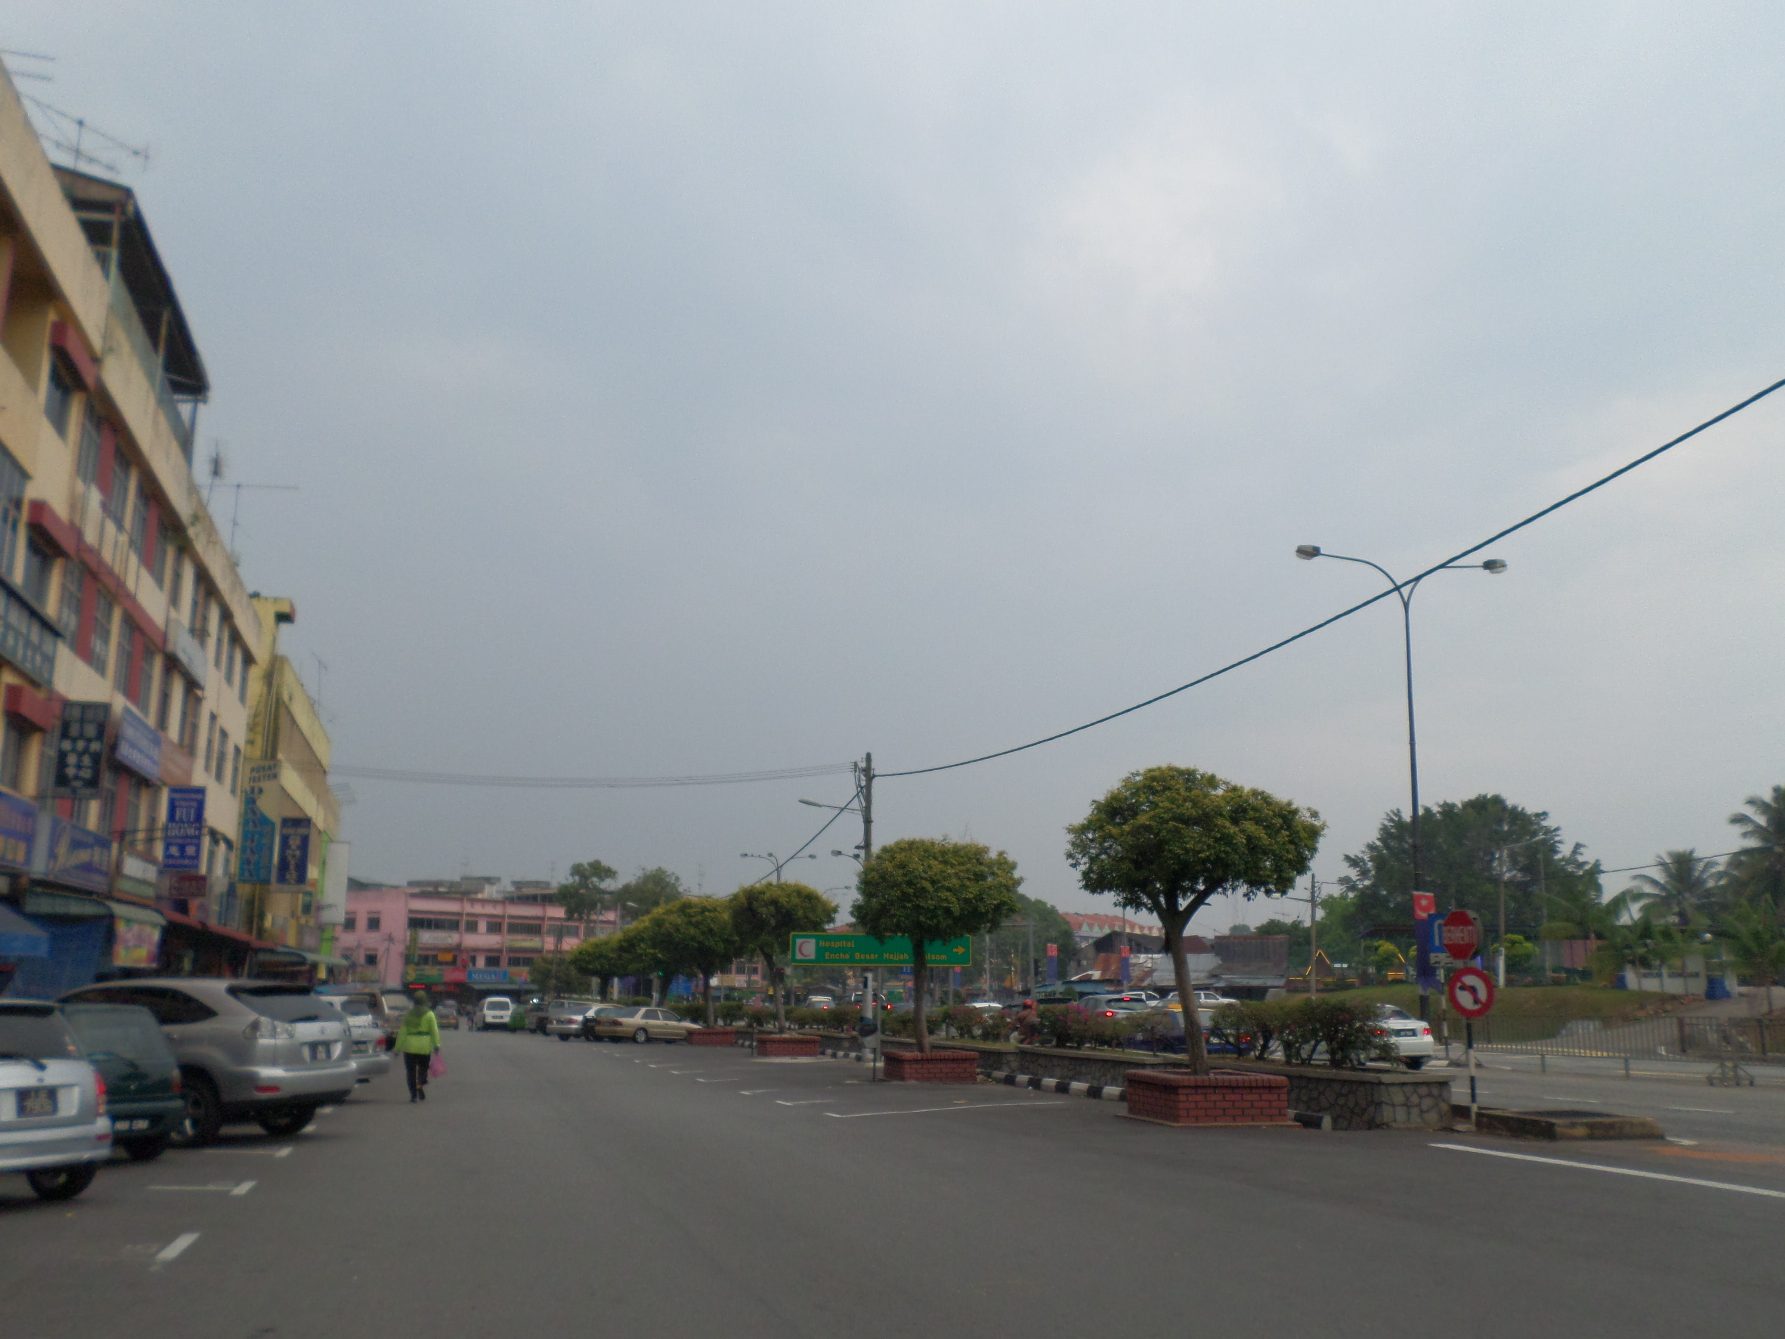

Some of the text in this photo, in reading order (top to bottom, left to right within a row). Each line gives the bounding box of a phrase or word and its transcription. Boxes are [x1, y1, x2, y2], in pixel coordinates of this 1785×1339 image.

[819, 939, 855, 949] Hospital
[825, 952, 850, 960] Enche
[855, 952, 879, 960] Besar
[883, 952, 909, 961] Hajjah
